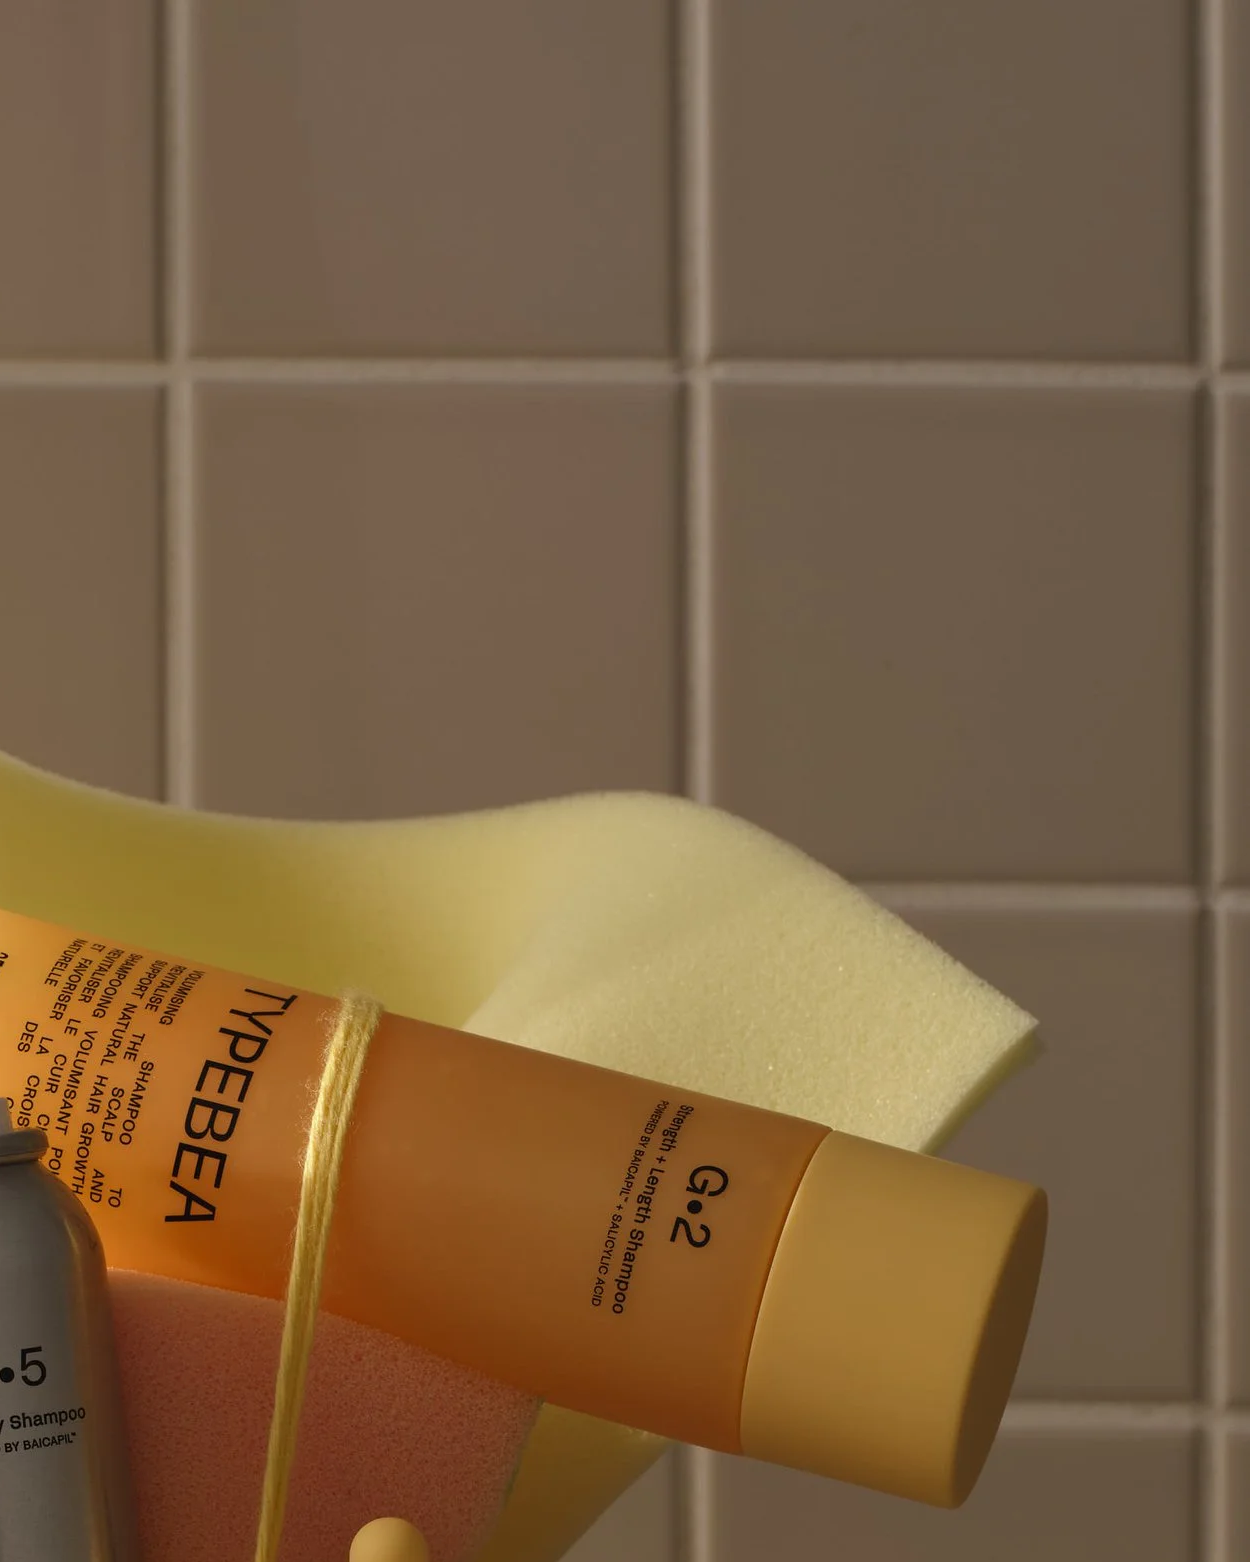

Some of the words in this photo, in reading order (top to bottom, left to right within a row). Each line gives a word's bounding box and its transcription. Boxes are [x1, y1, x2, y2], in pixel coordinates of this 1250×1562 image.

[44, 938, 88, 987] NATURELLE
[92, 943, 105, 954] ET
[49, 958, 93, 1021] FAVORISER
[77, 948, 124, 1005] REVITALISER
[91, 953, 144, 1019] SHAMPOOING
[131, 959, 168, 1000] SUPPORT
[145, 965, 187, 1013] REVITALISE
[159, 970, 205, 1026] VOLUMISING
[17, 1020, 39, 1054] DES
[35, 1035, 53, 1056] LA
[63, 1017, 82, 1037] LE
[100, 1003, 138, 1068] NATURAL
[122, 1032, 146, 1063] THE
[44, 1053, 67, 1094] CUIR
[55, 1030, 98, 1136] VOLUMISANT
[85, 1075, 109, 1115] HAIR
[101, 1087, 125, 1143] SCALP
[119, 1060, 154, 1146] SHAMPOO
[164, 988, 299, 1223] TYPEBEA
[644, 1100, 670, 1135] POWERED
[638, 1135, 650, 1148] BY
[661, 1104, 695, 1152] Strength
[89, 1168, 105, 1204] AND
[108, 1186, 122, 1208] TO
[633, 1167, 665, 1224] Length
[598, 1214, 623, 1275] SALICYLIC
[591, 1276, 605, 1307] ACID
[612, 1228, 645, 1315] Shampoo
[10, 1407, 86, 1430] Shampoo
[5, 1441, 20, 1453] BY
